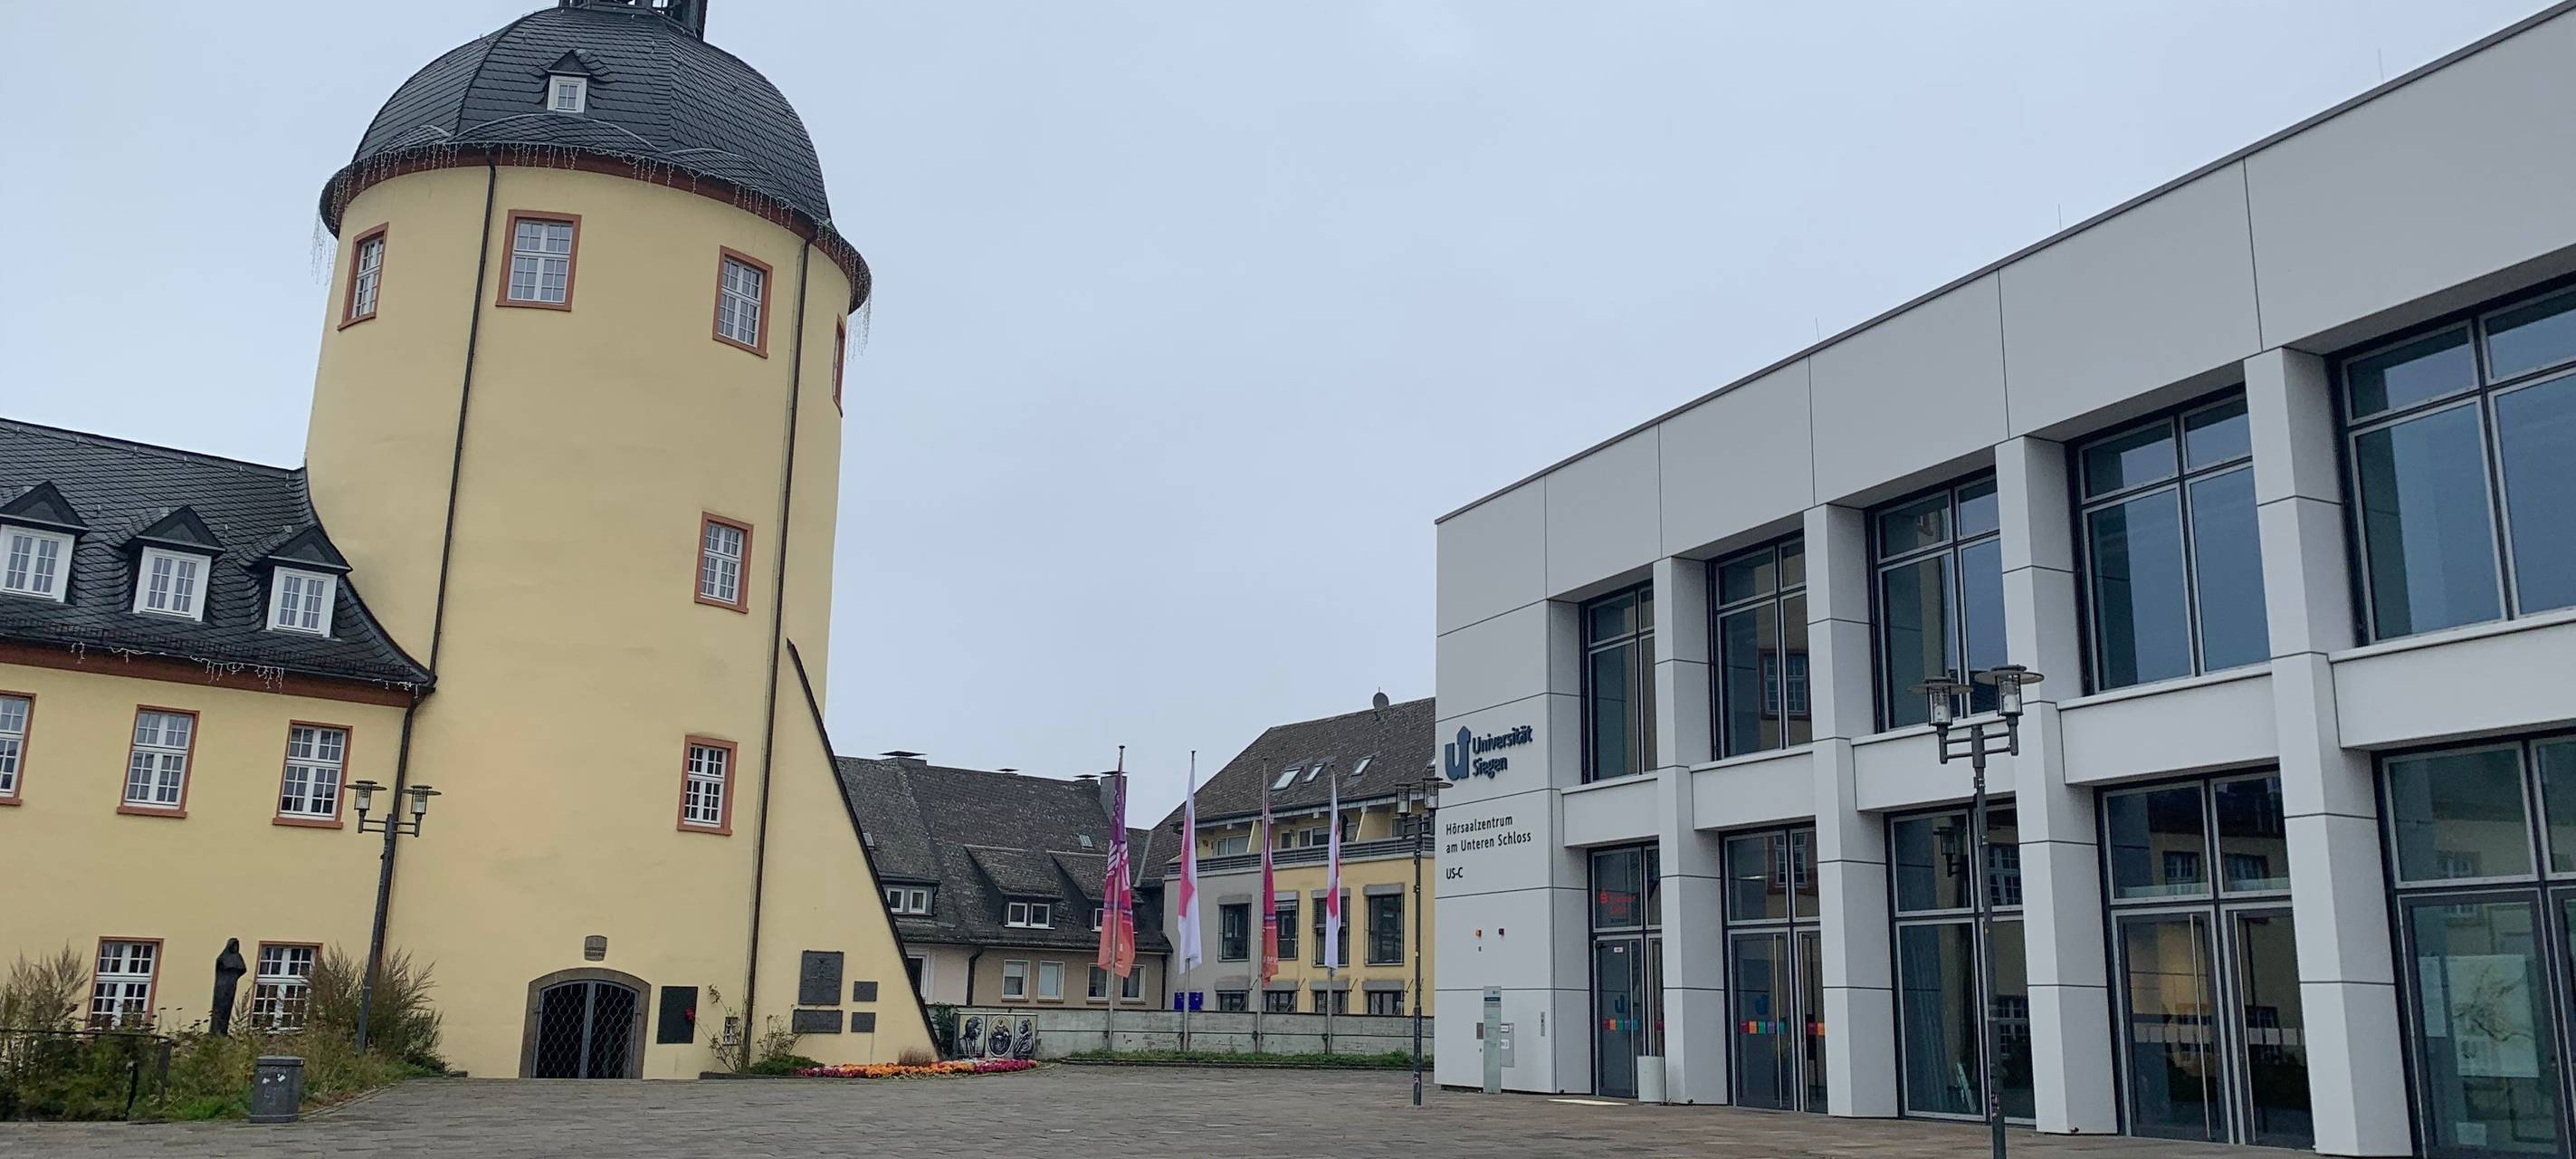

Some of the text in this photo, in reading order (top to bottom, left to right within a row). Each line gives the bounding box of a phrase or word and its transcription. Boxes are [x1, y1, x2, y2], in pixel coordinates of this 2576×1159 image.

[1472, 726, 1532, 754] Universität
[1473, 757, 1507, 779] Siegen
[1445, 816, 1513, 836] Hörsaalzentrum
[1445, 831, 1531, 854] am Unteren Schloss
[1445, 867, 1464, 879] US-C
